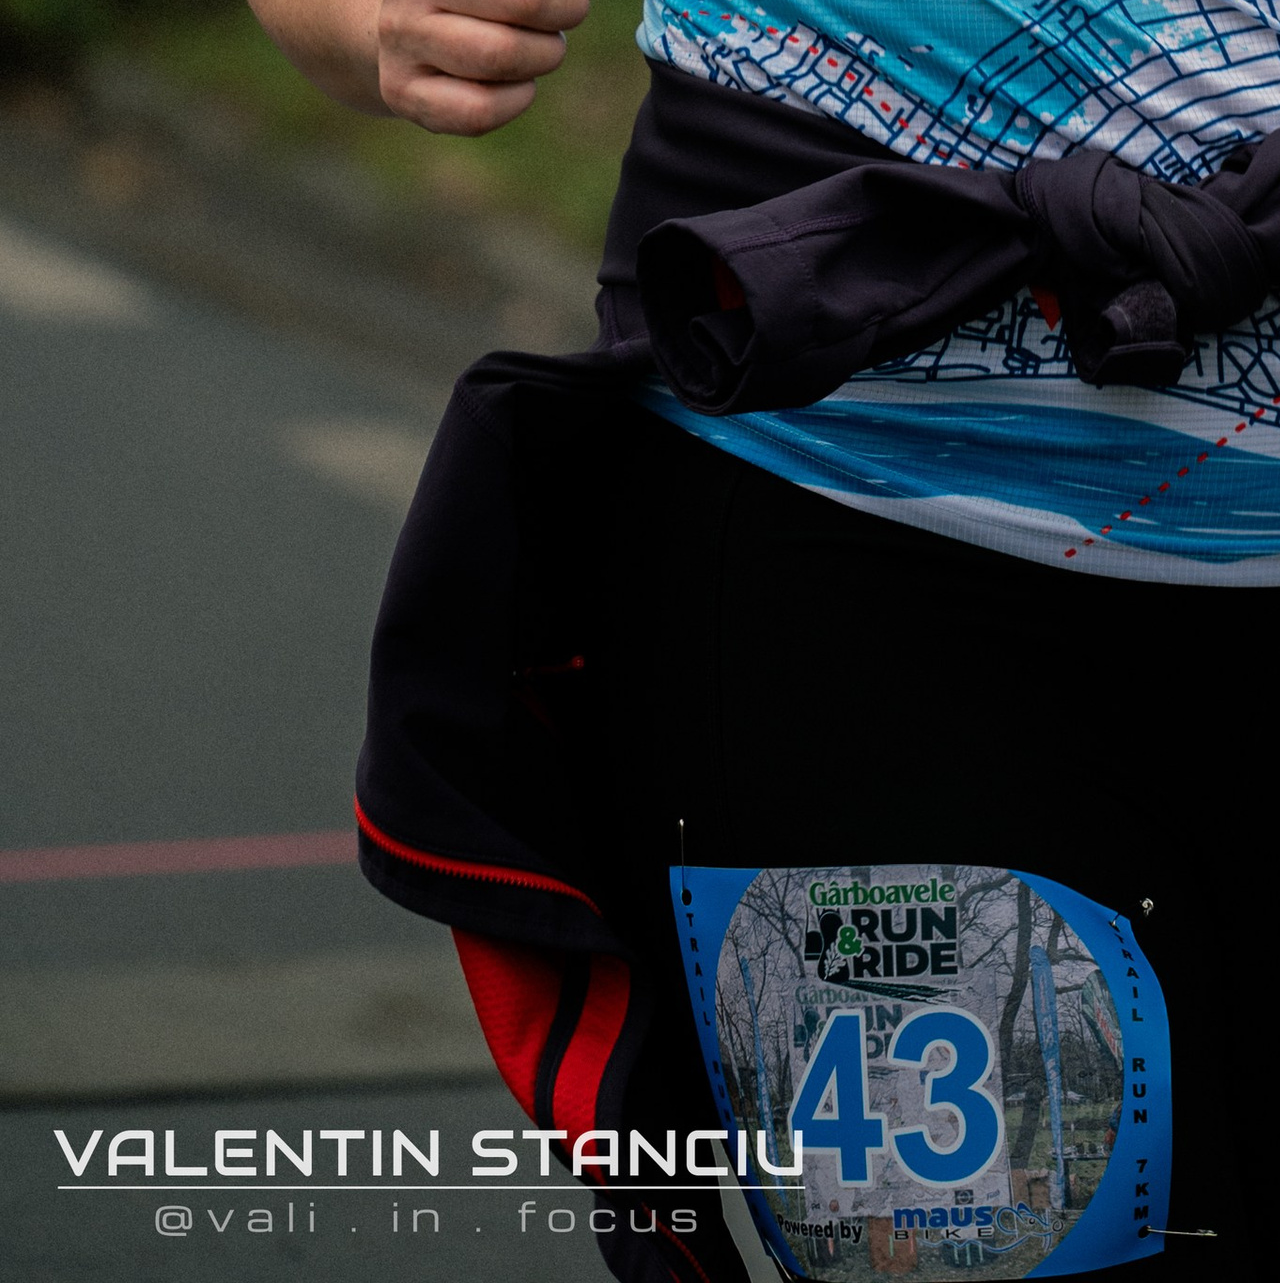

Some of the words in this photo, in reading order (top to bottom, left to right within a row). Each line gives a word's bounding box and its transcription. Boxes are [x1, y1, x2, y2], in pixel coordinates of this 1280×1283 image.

[809, 878, 955, 906] Gârboavele
[851, 906, 958, 942] RUN
[686, 914, 711, 1026] TRAIL
[837, 926, 862, 956] &
[853, 943, 958, 978] RIDE
[1114, 933, 1144, 1023] TRAIL
[788, 1007, 1004, 1188] 43
[1132, 1057, 1148, 1124] RUN
[1134, 1159, 1149, 1220] 7KM
[776, 1213, 834, 1239] Powered
[840, 1220, 863, 1244] by
[894, 1205, 994, 1228] maus
[894, 1228, 994, 1240] BIKE
